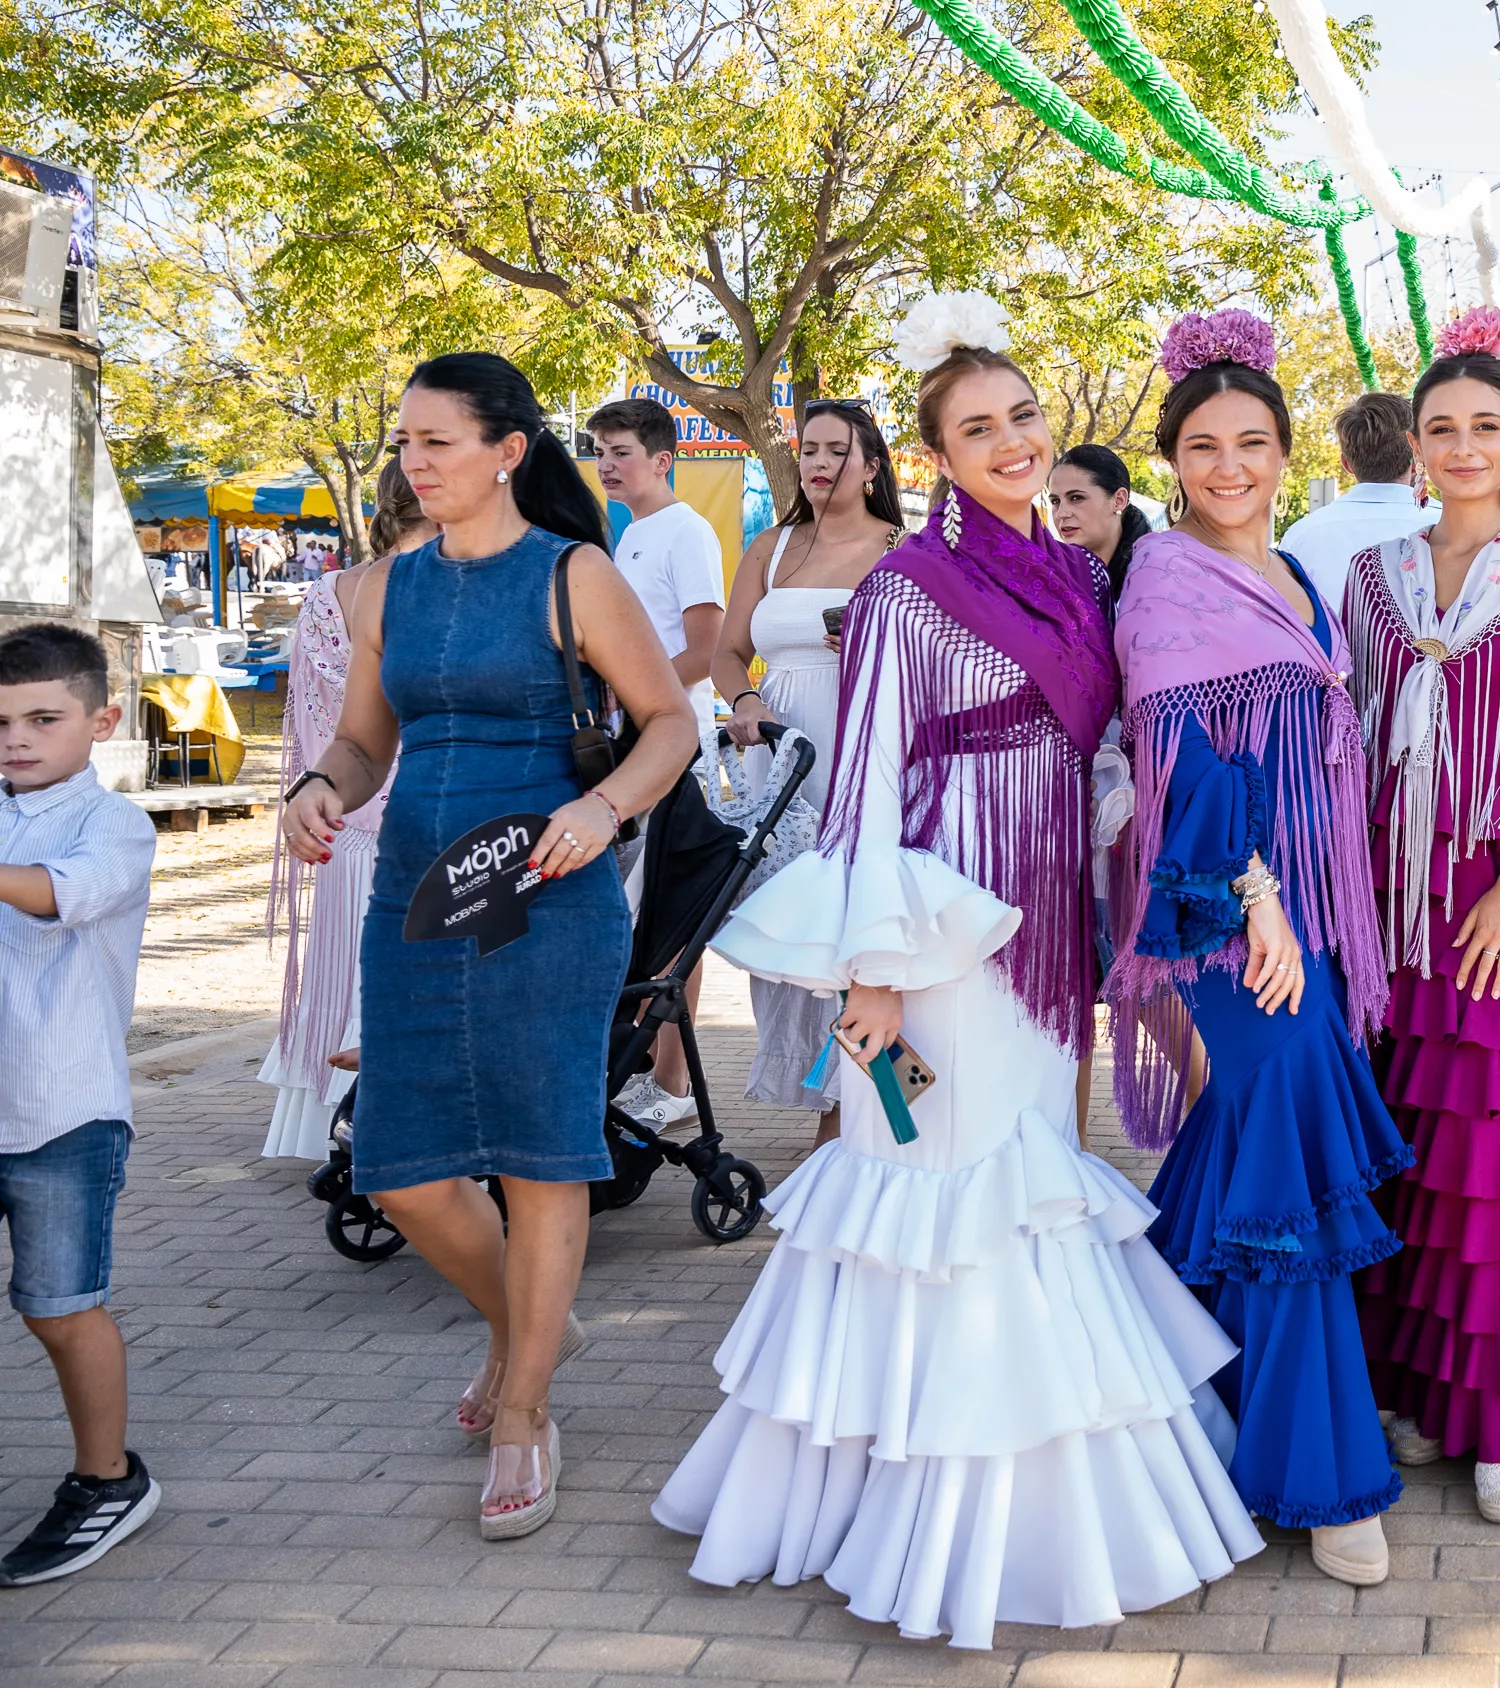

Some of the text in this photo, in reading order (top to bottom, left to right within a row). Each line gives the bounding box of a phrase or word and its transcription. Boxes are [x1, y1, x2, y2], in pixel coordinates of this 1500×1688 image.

[446, 825, 530, 885] Möph
[515, 874, 543, 894] JURAD
[444, 898, 489, 927] MOBASS
